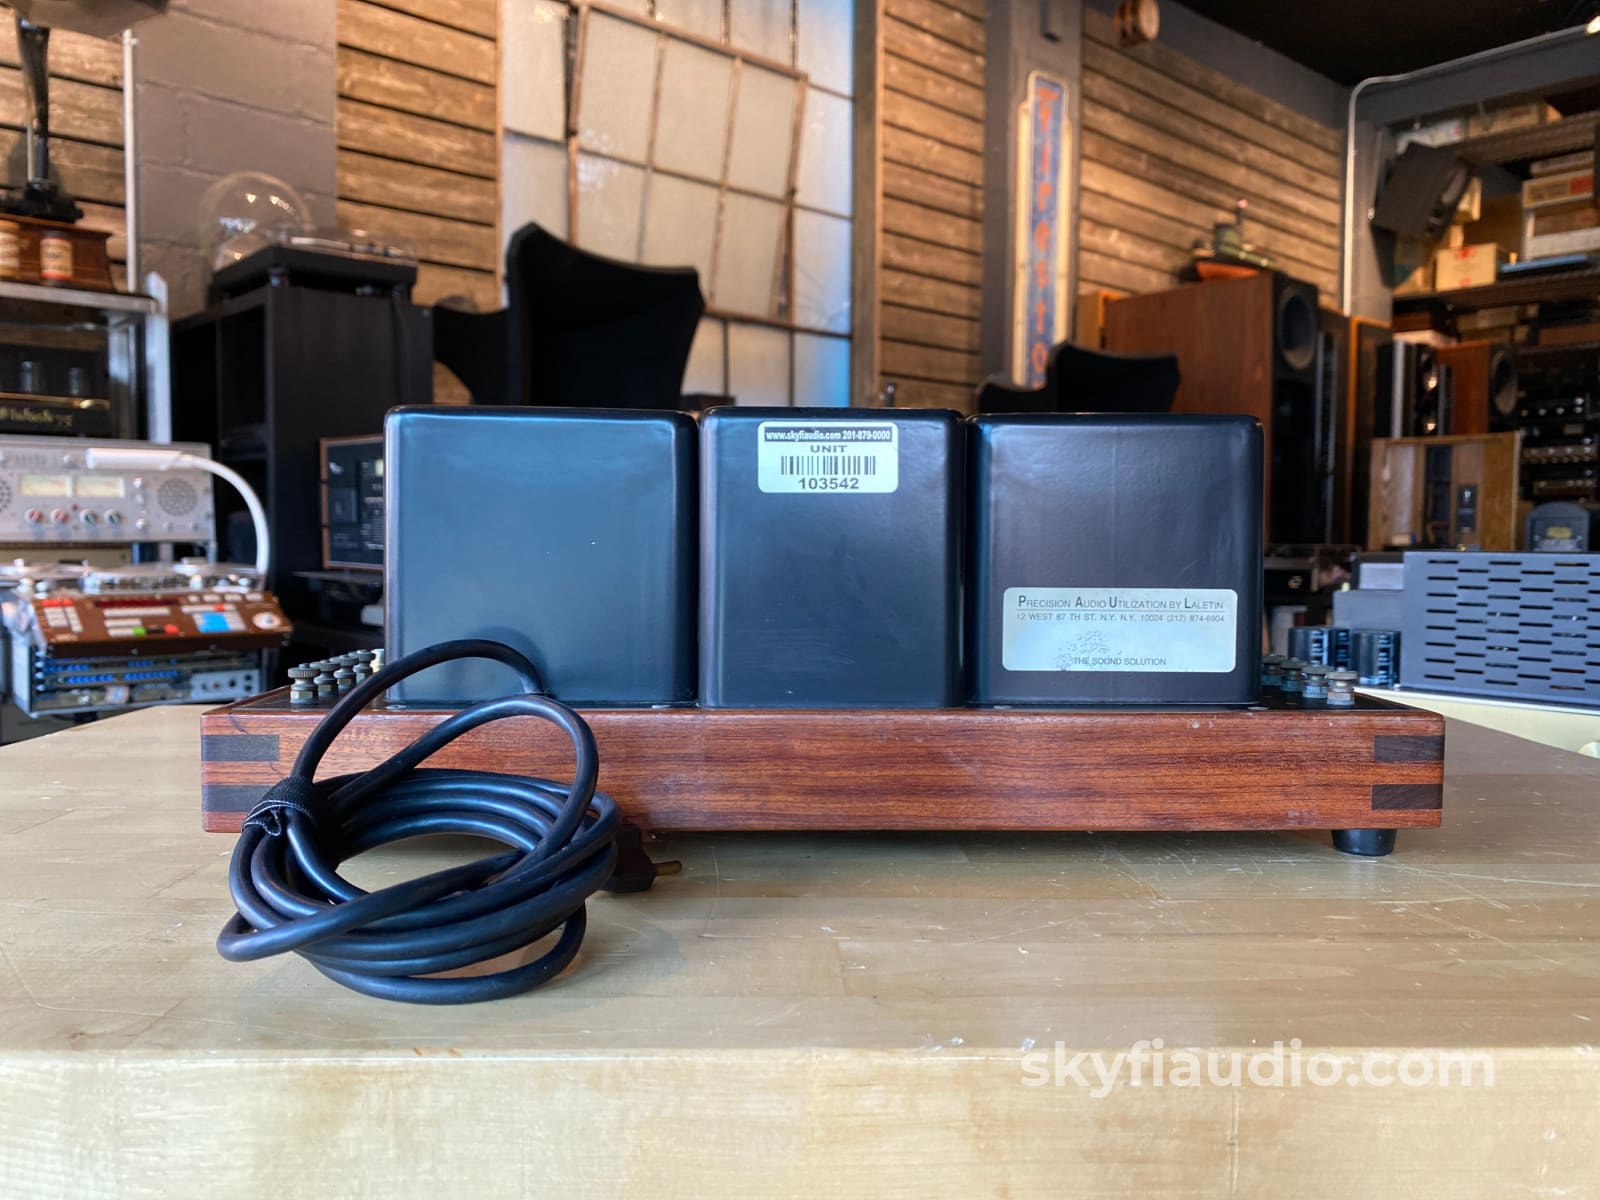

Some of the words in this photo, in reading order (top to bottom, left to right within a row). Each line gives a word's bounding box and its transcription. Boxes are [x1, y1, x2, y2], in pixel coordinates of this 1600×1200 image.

[766, 429, 841, 442] www.skyfiaudio.com
[842, 430, 891, 440] 201-879-0000
[810, 444, 848, 453] UNIT
[799, 477, 860, 490] 103542
[1169, 600, 1182, 609] BY
[1016, 613, 1026, 621] 12
[1029, 613, 1052, 621] WEST
[1070, 613, 1081, 621] TH
[1083, 613, 1097, 621] ST.
[1141, 614, 1163, 622] 10024
[1166, 614, 1186, 623] (212)
[1073, 656, 1090, 665] THE
[1091, 657, 1122, 665] SOUND
[1123, 657, 1167, 666] SOLUTION
